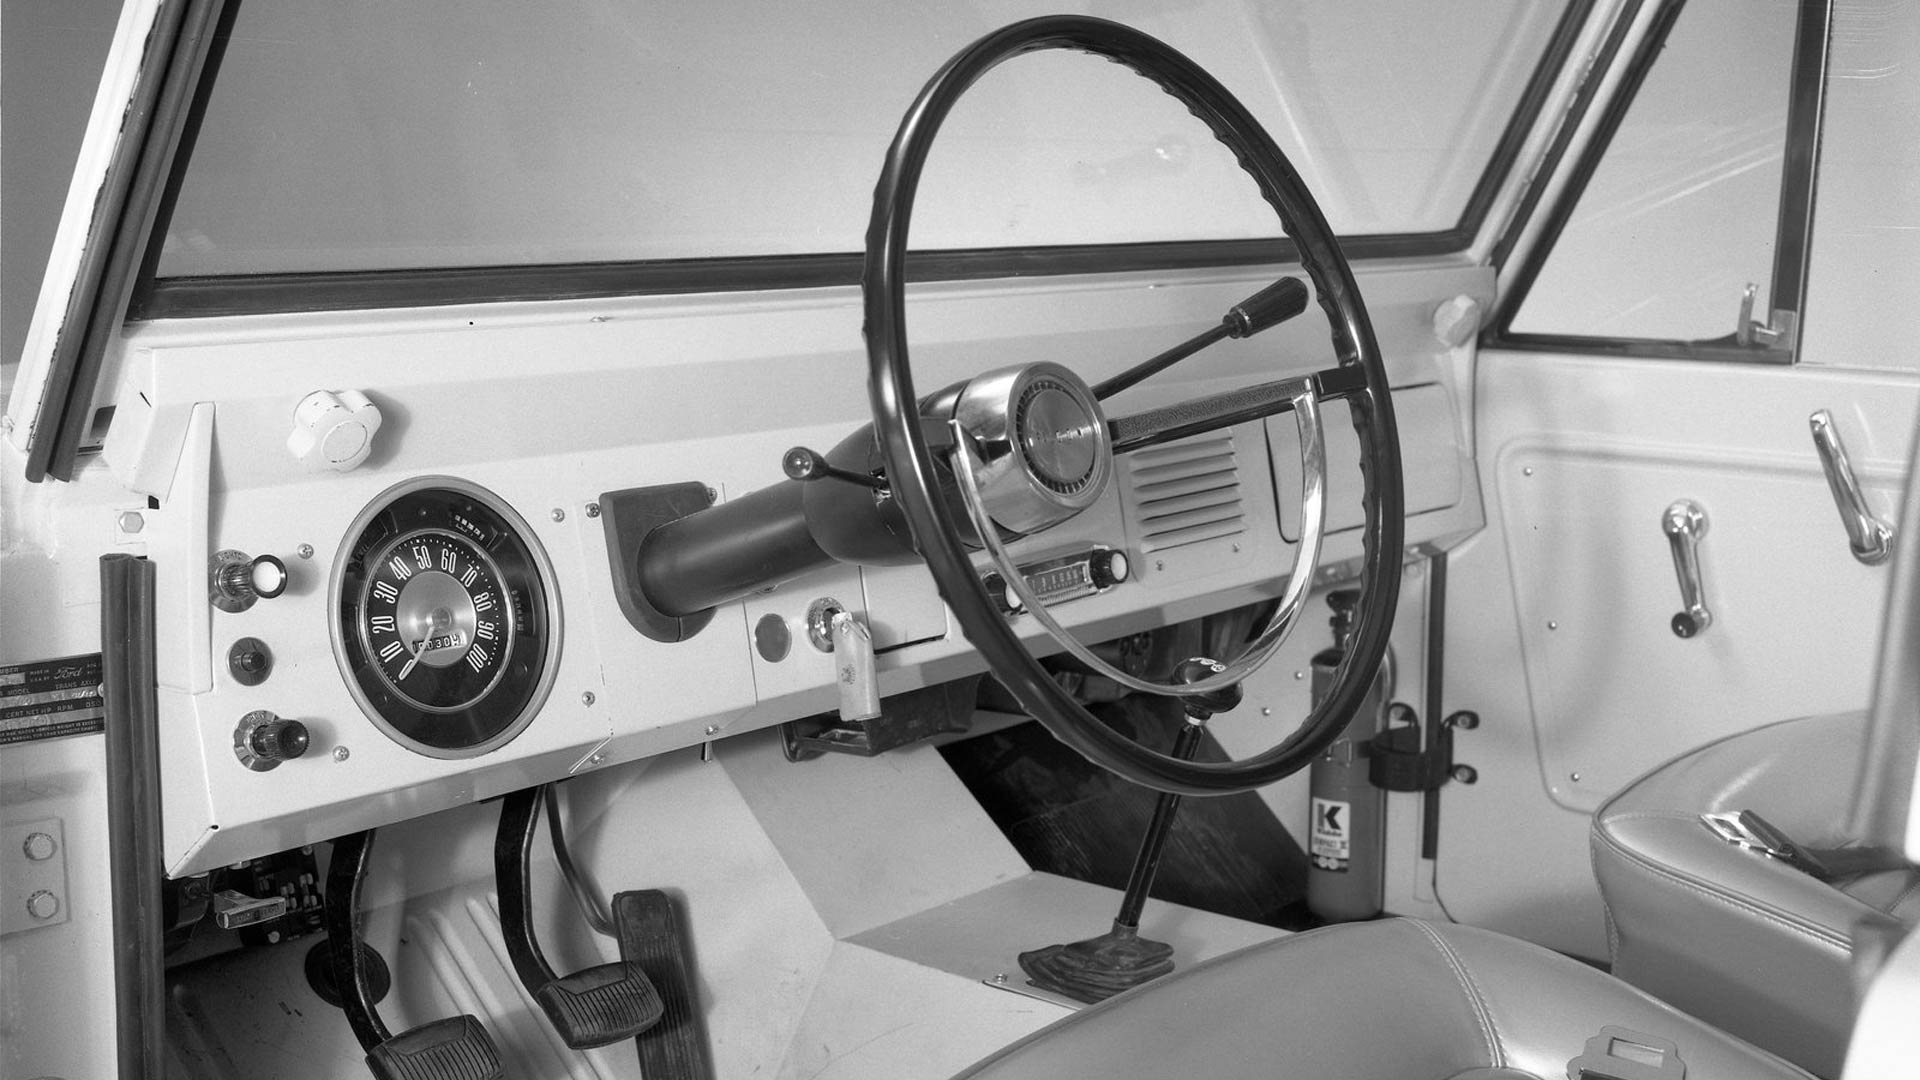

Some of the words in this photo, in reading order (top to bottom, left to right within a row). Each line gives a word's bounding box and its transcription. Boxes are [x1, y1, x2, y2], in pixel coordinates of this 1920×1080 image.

[389, 555, 412, 581] 40
[412, 545, 432, 570] 50
[440, 548, 457, 574] 60
[460, 563, 478, 588] 70
[373, 581, 399, 604] 30
[474, 592, 492, 612] 80
[371, 615, 396, 635] 20
[477, 620, 495, 641] 90
[379, 640, 404, 663] 10
[466, 643, 489, 674] 100
[54, 666, 82, 679] Ford
[1318, 803, 1342, 830] K
